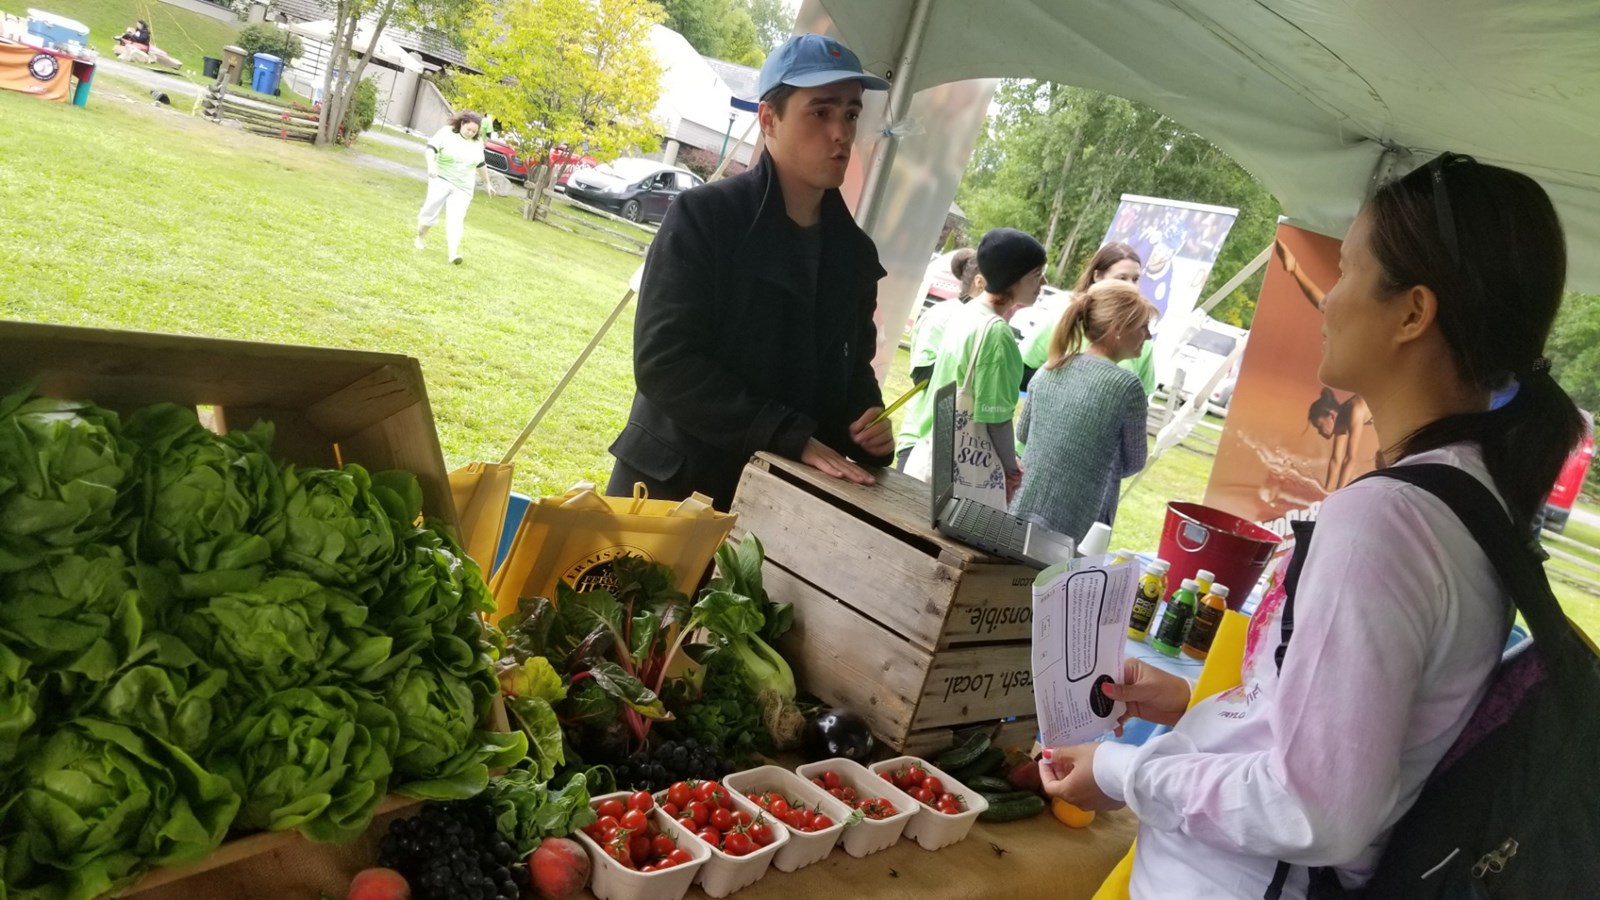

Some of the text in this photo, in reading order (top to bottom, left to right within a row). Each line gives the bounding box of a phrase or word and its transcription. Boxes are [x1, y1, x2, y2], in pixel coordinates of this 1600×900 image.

[957, 446, 993, 468] sac
[967, 606, 1034, 634] onsible.
[943, 668, 1035, 703] resh. Local.
[1217, 710, 1247, 720] TAYLO
